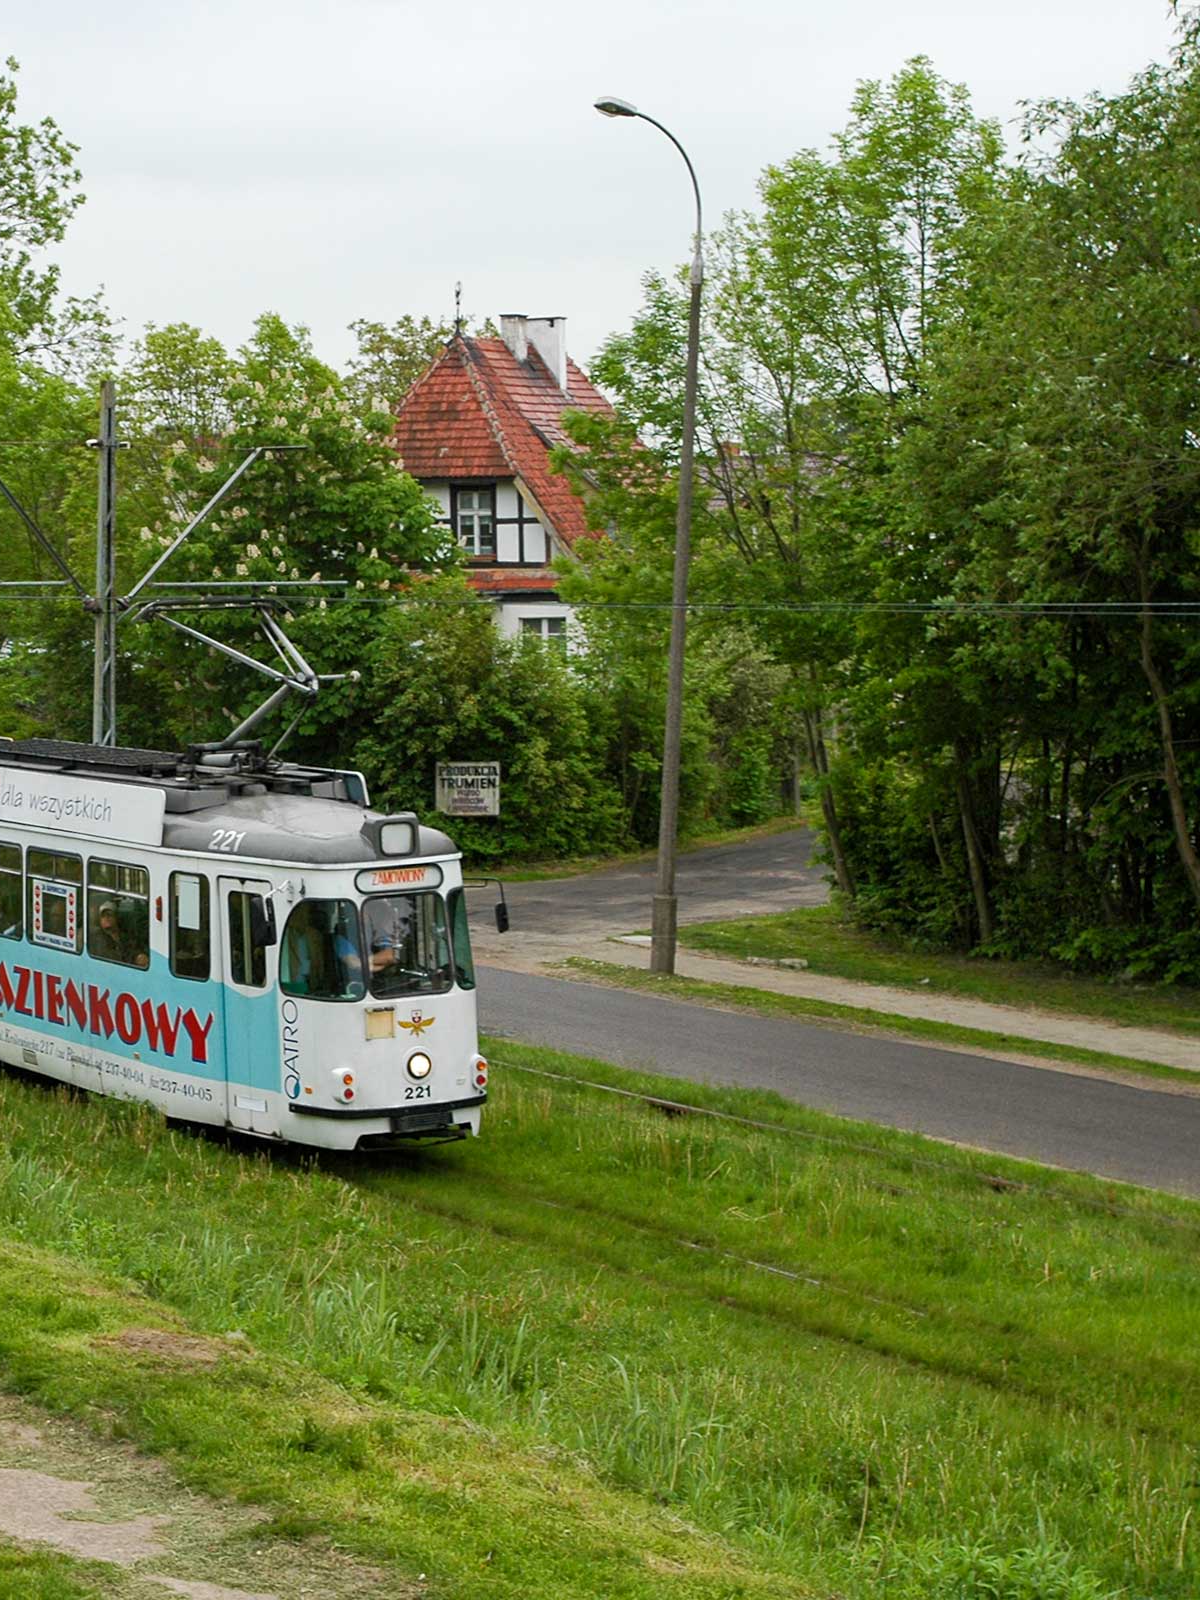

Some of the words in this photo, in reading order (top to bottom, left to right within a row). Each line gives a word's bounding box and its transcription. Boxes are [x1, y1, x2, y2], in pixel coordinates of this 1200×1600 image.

[439, 766, 498, 777] PRODUKCJA
[440, 778, 496, 789] TRUMIEN
[1, 784, 22, 806] dla
[29, 793, 112, 823] wszystkich
[208, 829, 247, 852] 221
[282, 999, 301, 1099] QATRO
[160, 1078, 213, 1101] 237-40-05
[405, 1085, 431, 1100] 221
